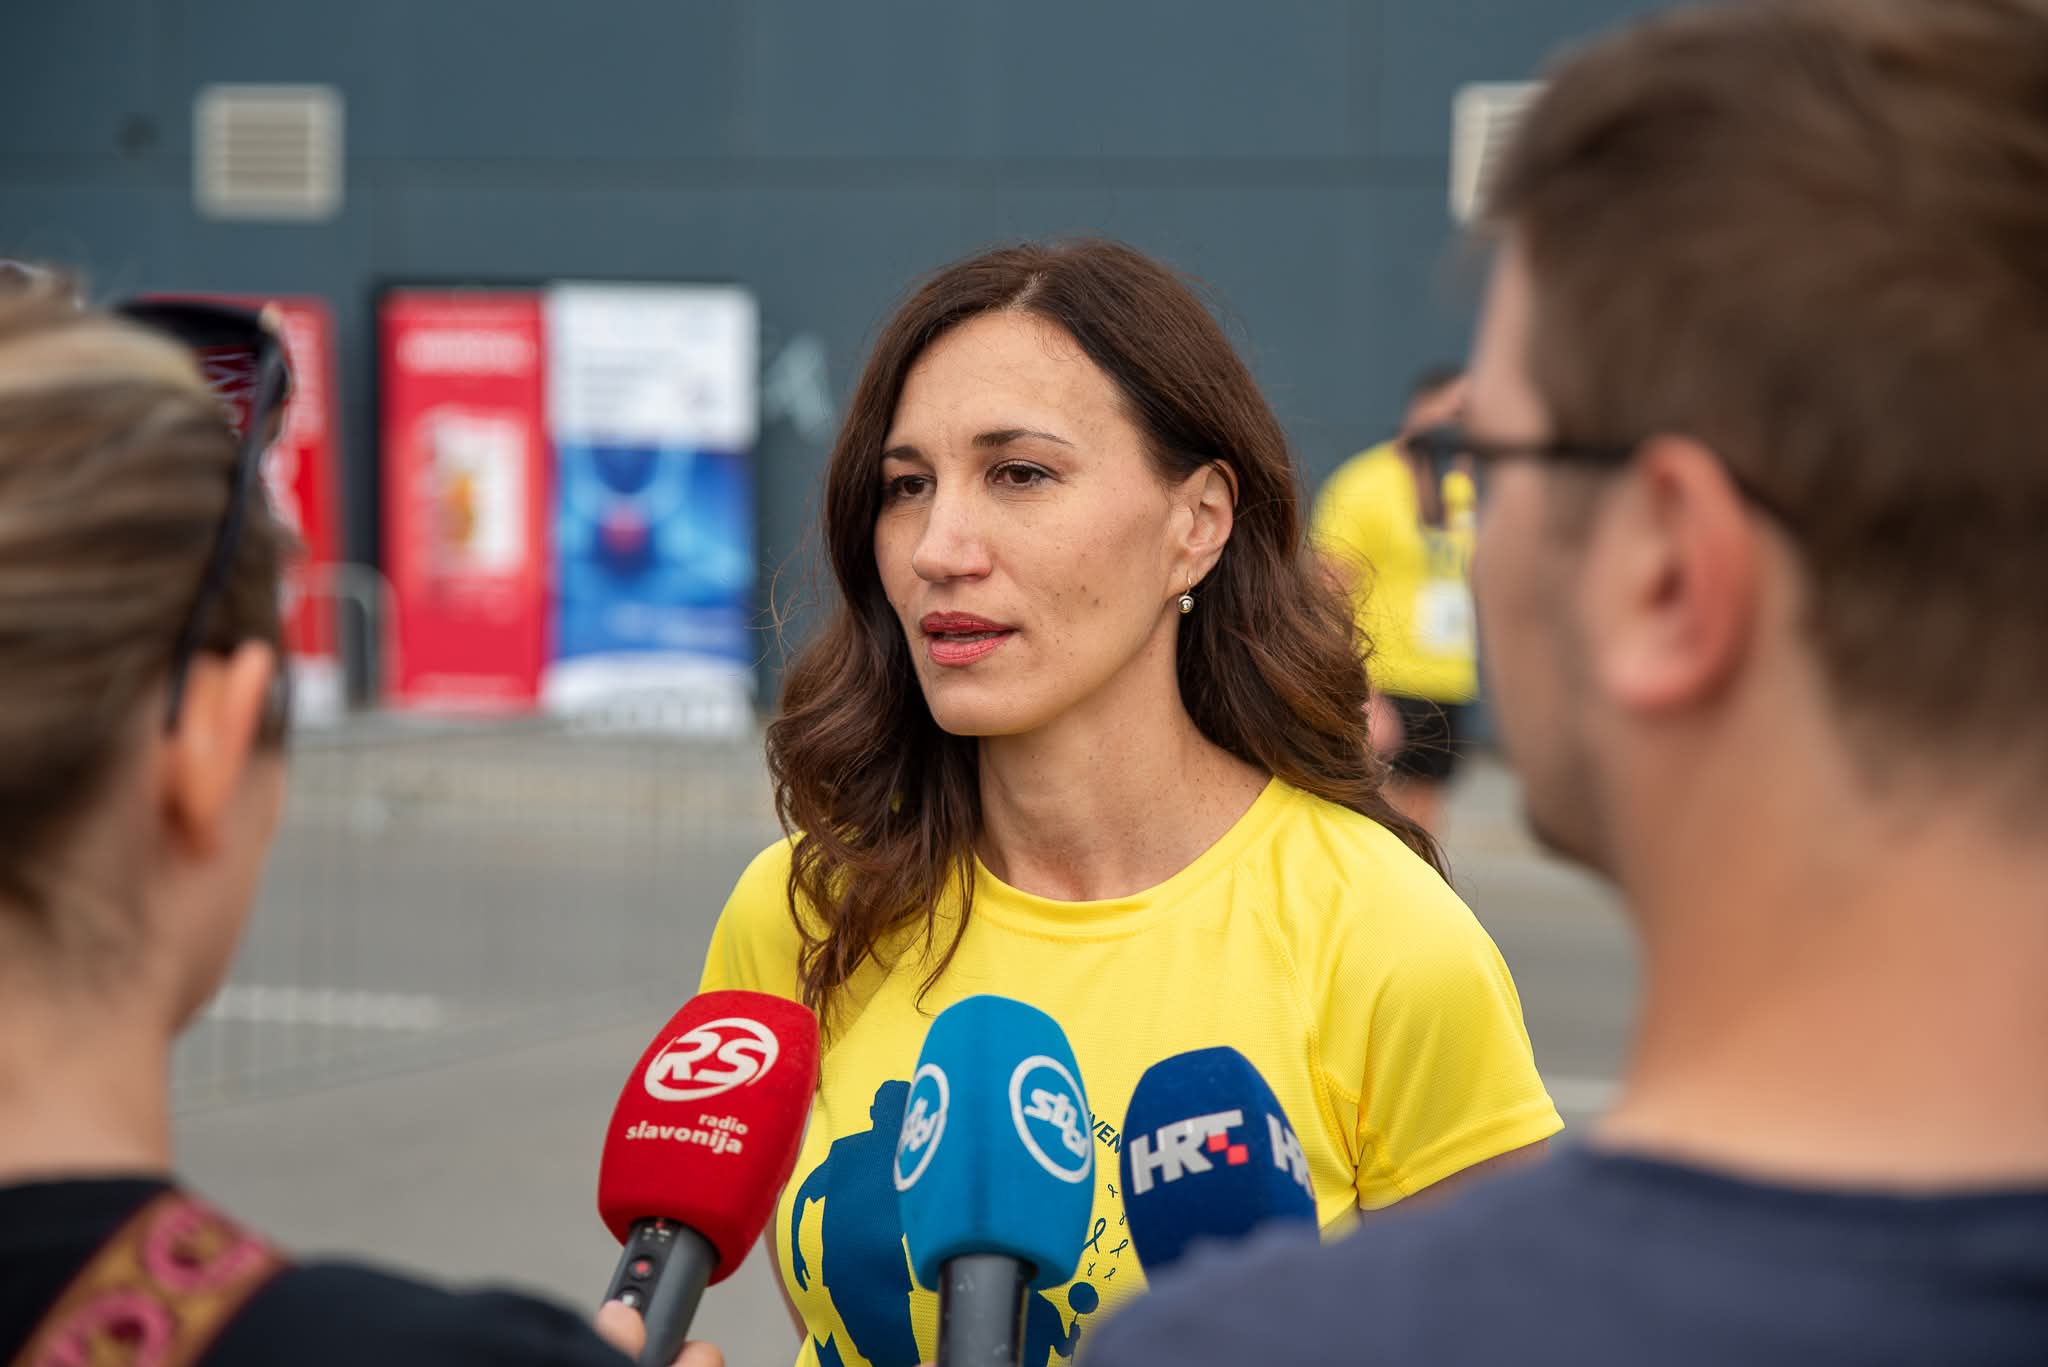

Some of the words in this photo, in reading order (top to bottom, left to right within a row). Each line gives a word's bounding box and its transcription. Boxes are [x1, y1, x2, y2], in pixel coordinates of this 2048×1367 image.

[652, 1029, 772, 1086] RS
[625, 1120, 743, 1155] slavonija
[698, 1113, 749, 1135] radio
[1088, 1111, 1121, 1154] VEN
[1129, 1108, 1244, 1196] HRT
[1266, 1112, 1314, 1200] HR
